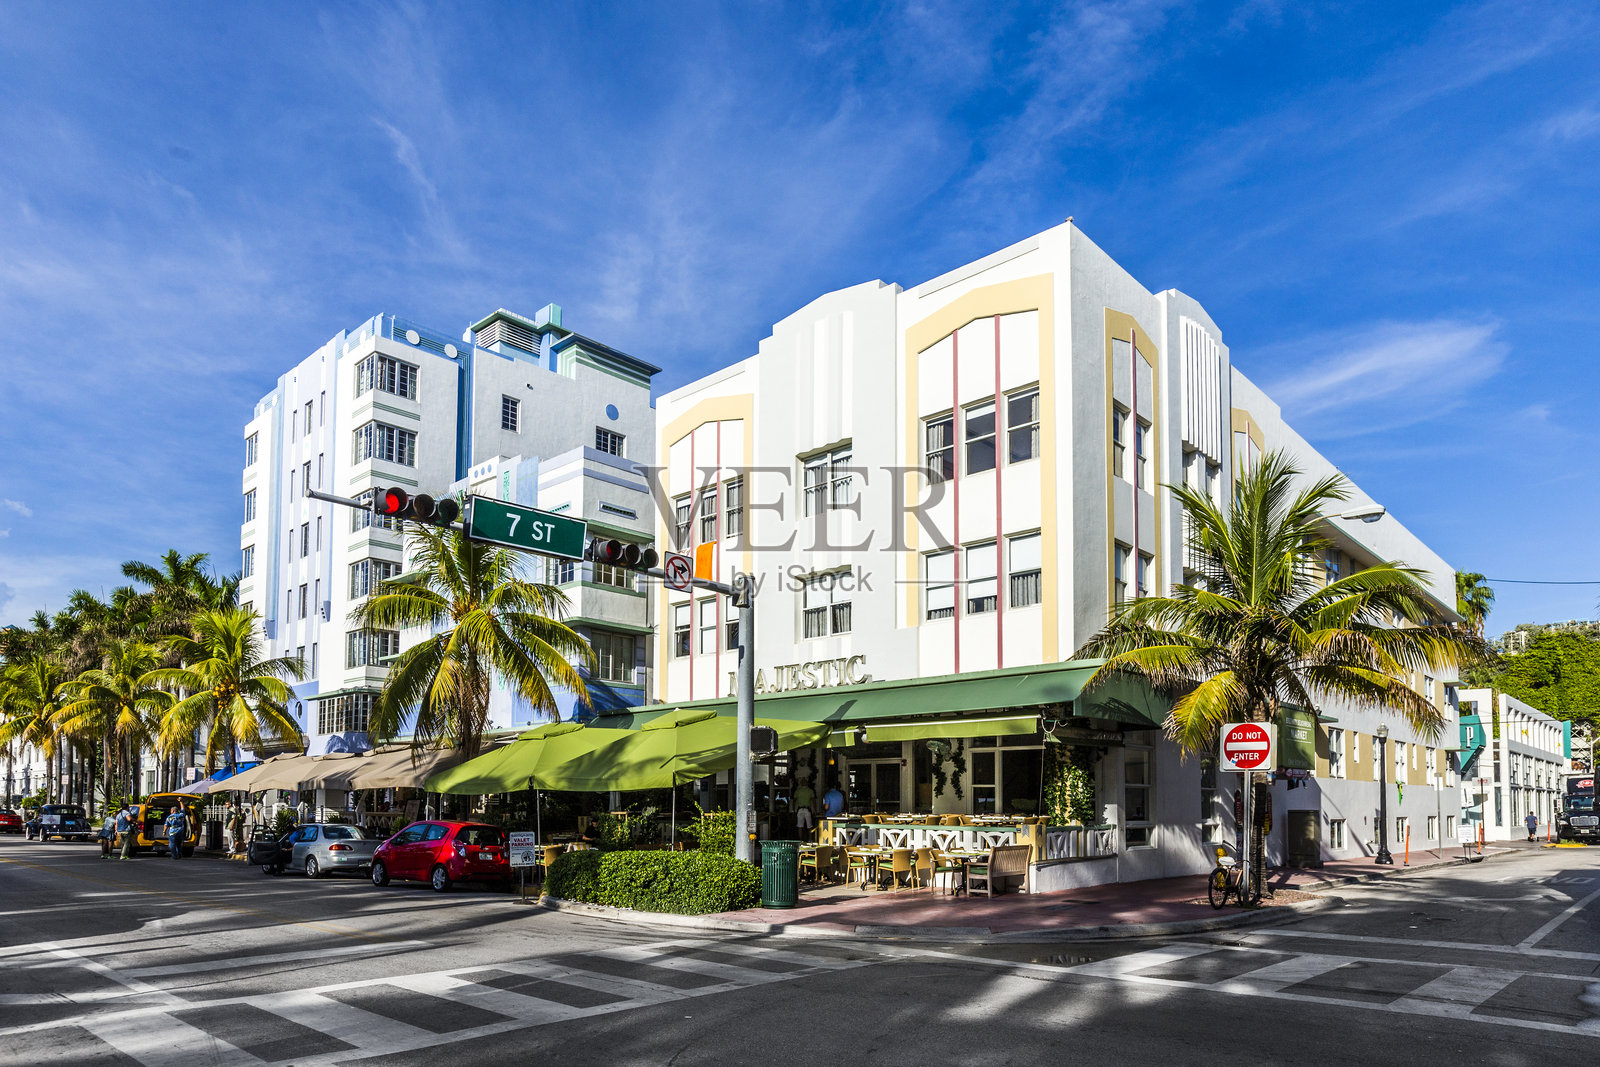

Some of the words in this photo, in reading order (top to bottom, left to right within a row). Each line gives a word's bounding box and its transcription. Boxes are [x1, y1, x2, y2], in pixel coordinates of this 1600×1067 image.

[507, 512, 521, 537] 7
[531, 521, 555, 543] ST
[1232, 732, 1243, 740] DO
[1246, 731, 1262, 739] NOT
[1466, 727, 1474, 748] P
[1234, 752, 1259, 760] ENTER
